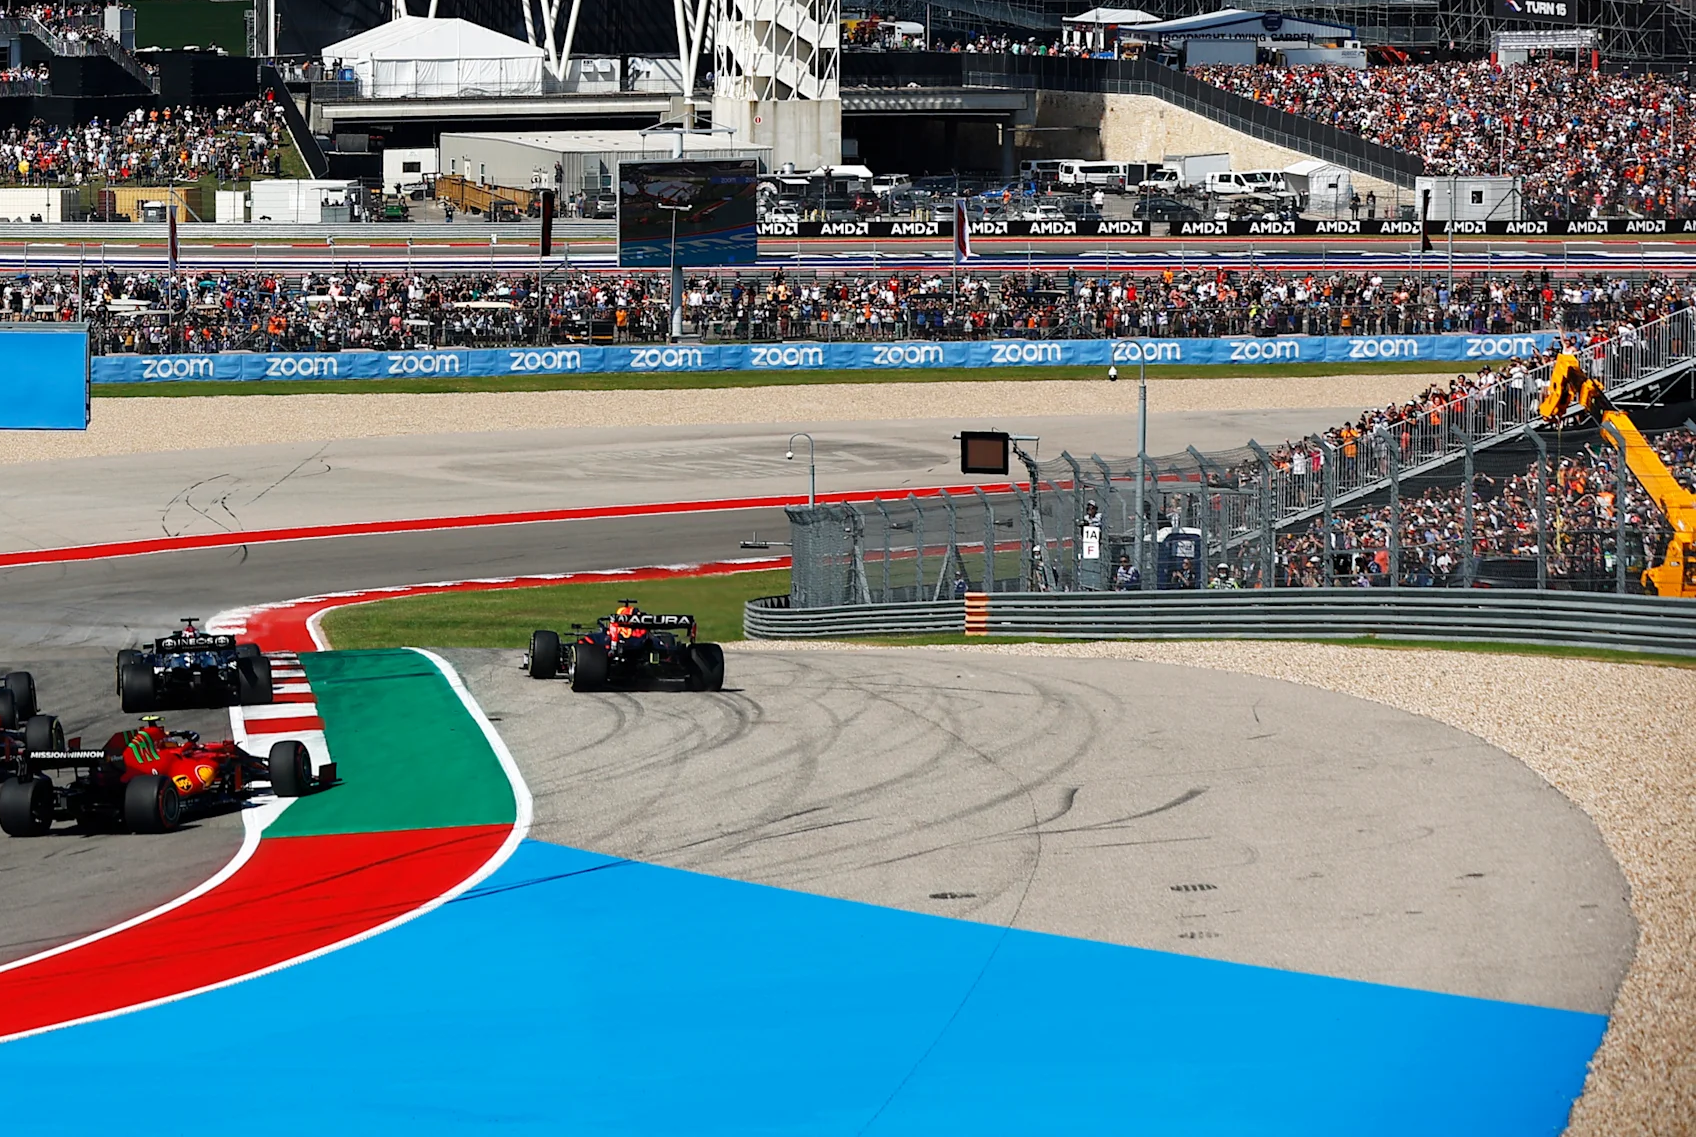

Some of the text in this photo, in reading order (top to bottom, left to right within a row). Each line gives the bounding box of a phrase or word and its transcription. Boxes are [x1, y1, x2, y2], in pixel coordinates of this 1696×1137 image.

[1525, 1, 1567, 17] TURN 15
[1271, 33, 1315, 43] GARDEN
[821, 223, 855, 235] AMD
[891, 223, 925, 235] AMD
[1030, 222, 1064, 234] AMD
[1097, 222, 1131, 234] AMD
[1181, 222, 1215, 234] AMD
[1250, 222, 1283, 234] AMD
[1316, 222, 1349, 233] AMD
[1380, 221, 1413, 234] AMD
[1506, 221, 1537, 233] AMD
[1567, 221, 1597, 233] AMD
[1626, 221, 1655, 232] AMD
[1111, 342, 1180, 361] zoom
[1230, 341, 1299, 360] zoom
[1349, 338, 1417, 358] zoom
[1466, 336, 1535, 356] zoom
[630, 348, 702, 368] zoom
[751, 346, 823, 366] zoom
[873, 345, 943, 364] zoom
[991, 343, 1061, 363] zoom
[266, 356, 338, 376] zoom
[388, 353, 459, 374] zoom
[510, 351, 580, 371] zoom
[142, 358, 214, 378] zoom
[1085, 529, 1097, 540] 1A
[1087, 546, 1094, 555] F
[628, 615, 691, 625] ACURA
[177, 638, 214, 647] INEOS
[30, 751, 66, 759] MISSION
[67, 750, 105, 759] WINNOW
